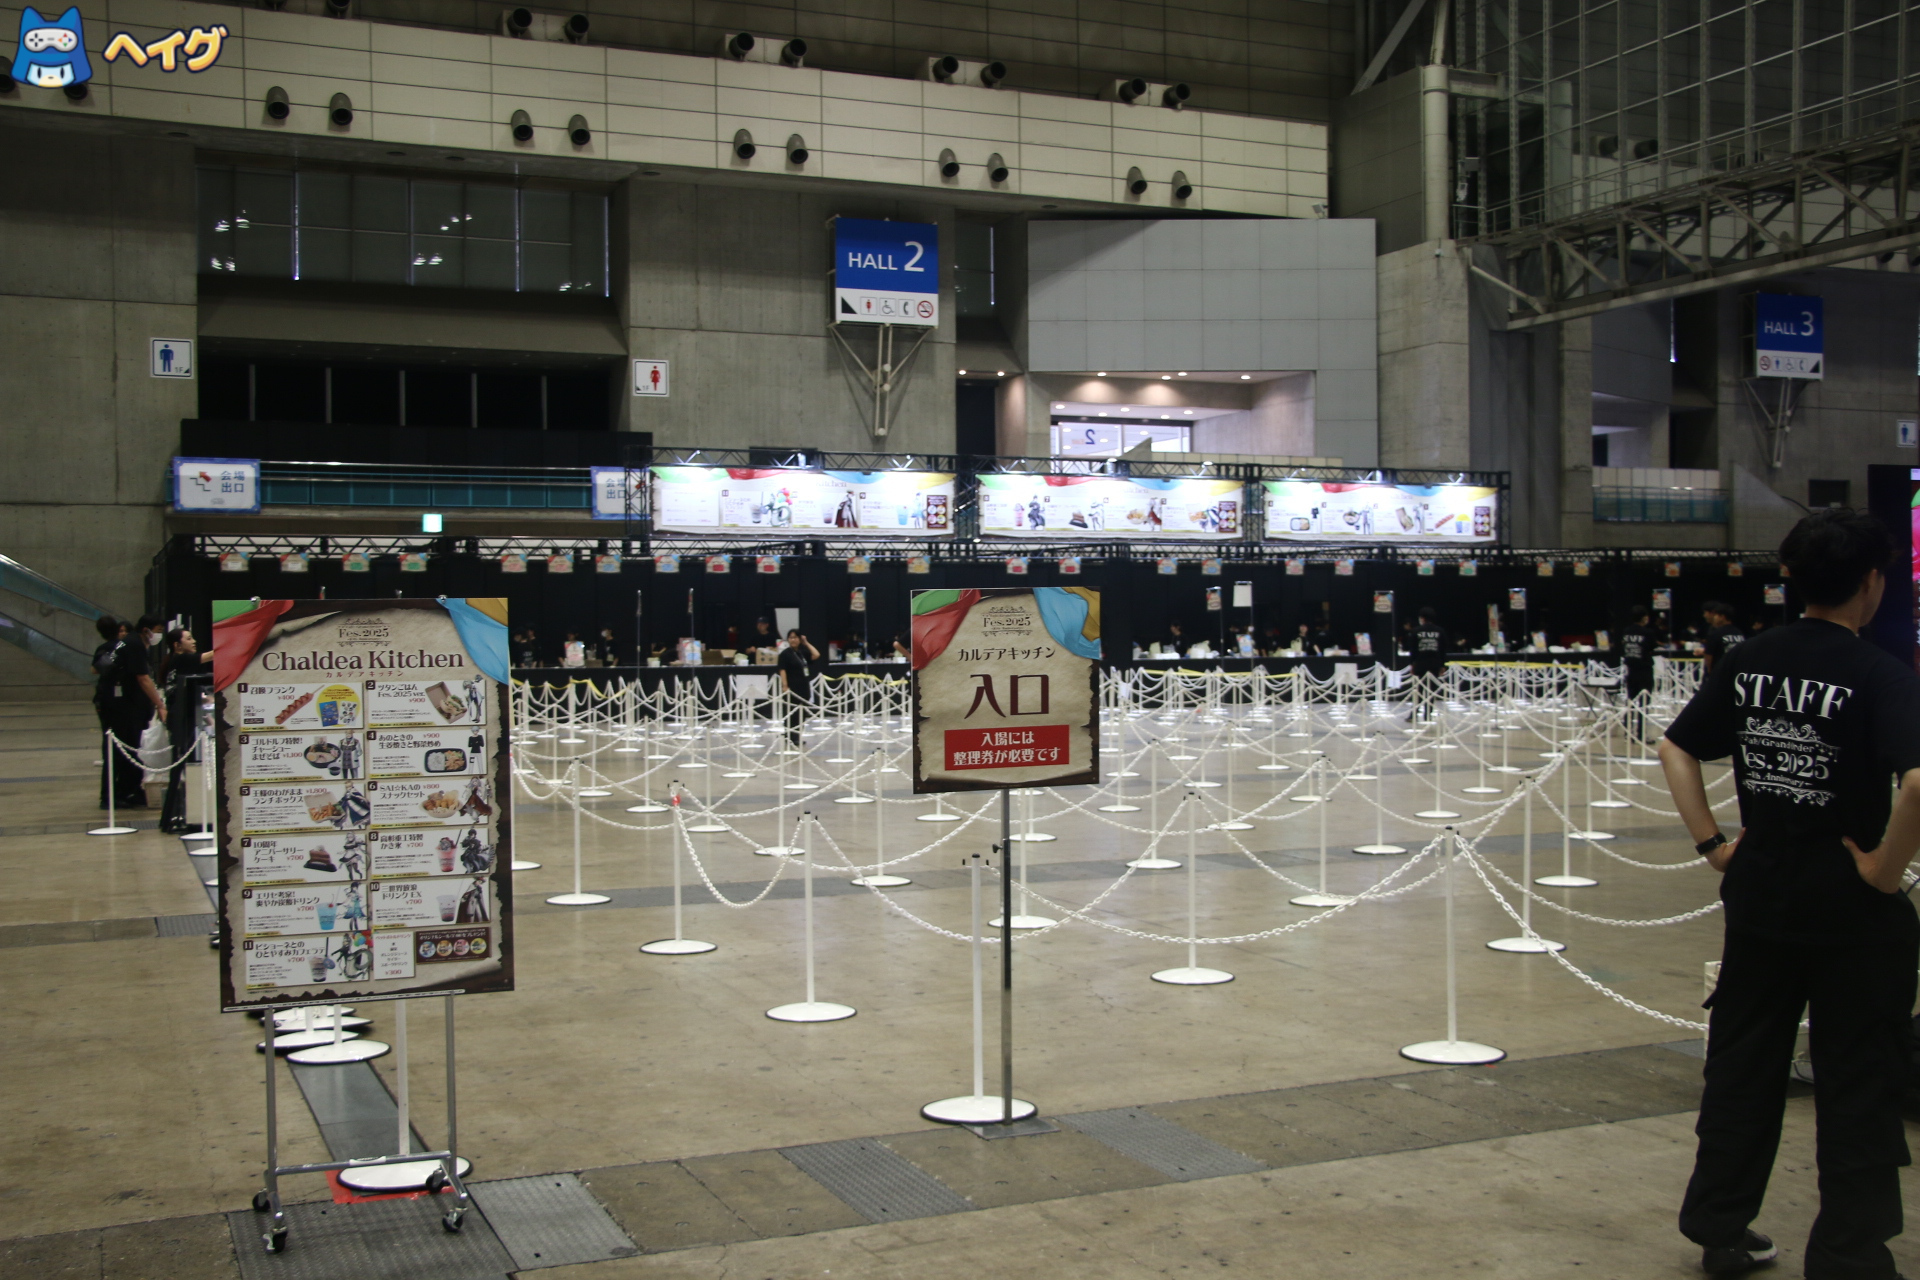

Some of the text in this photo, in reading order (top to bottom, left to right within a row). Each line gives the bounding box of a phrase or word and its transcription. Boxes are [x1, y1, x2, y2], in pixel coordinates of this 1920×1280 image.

[848, 241, 925, 272] HALL 2
[1764, 311, 1814, 336] HALL 3
[221, 471, 245, 481] 会場
[221, 482, 244, 493] 出口
[606, 489, 627, 499] 出口
[984, 616, 1031, 627] Fes. 2025
[339, 628, 389, 638] Fes. 2025
[958, 647, 1056, 661] カルデアキッチン
[262, 650, 464, 671] Chaldea Kitchen
[378, 684, 418, 692] ツタンごはん
[964, 674, 1049, 719] 入口
[1734, 672, 1853, 719] STAFF
[981, 731, 1034, 747] 入場には
[379, 741, 441, 749] 生姜焼きと野菜炒め
[252, 753, 280, 761] まぜそば
[953, 747, 1061, 766] 整理券が必要です
[1777, 751, 1830, 780] 2025
[253, 789, 303, 797] 王様のわがまま
[380, 791, 425, 799] スナックセット
[254, 796, 304, 804] ランチボックス
[255, 847, 304, 856] アニバーサリー
[254, 855, 276, 864] ケーキ
[382, 891, 408, 900] ドリンク
[255, 947, 325, 958] ひとやすみカフェラテ
